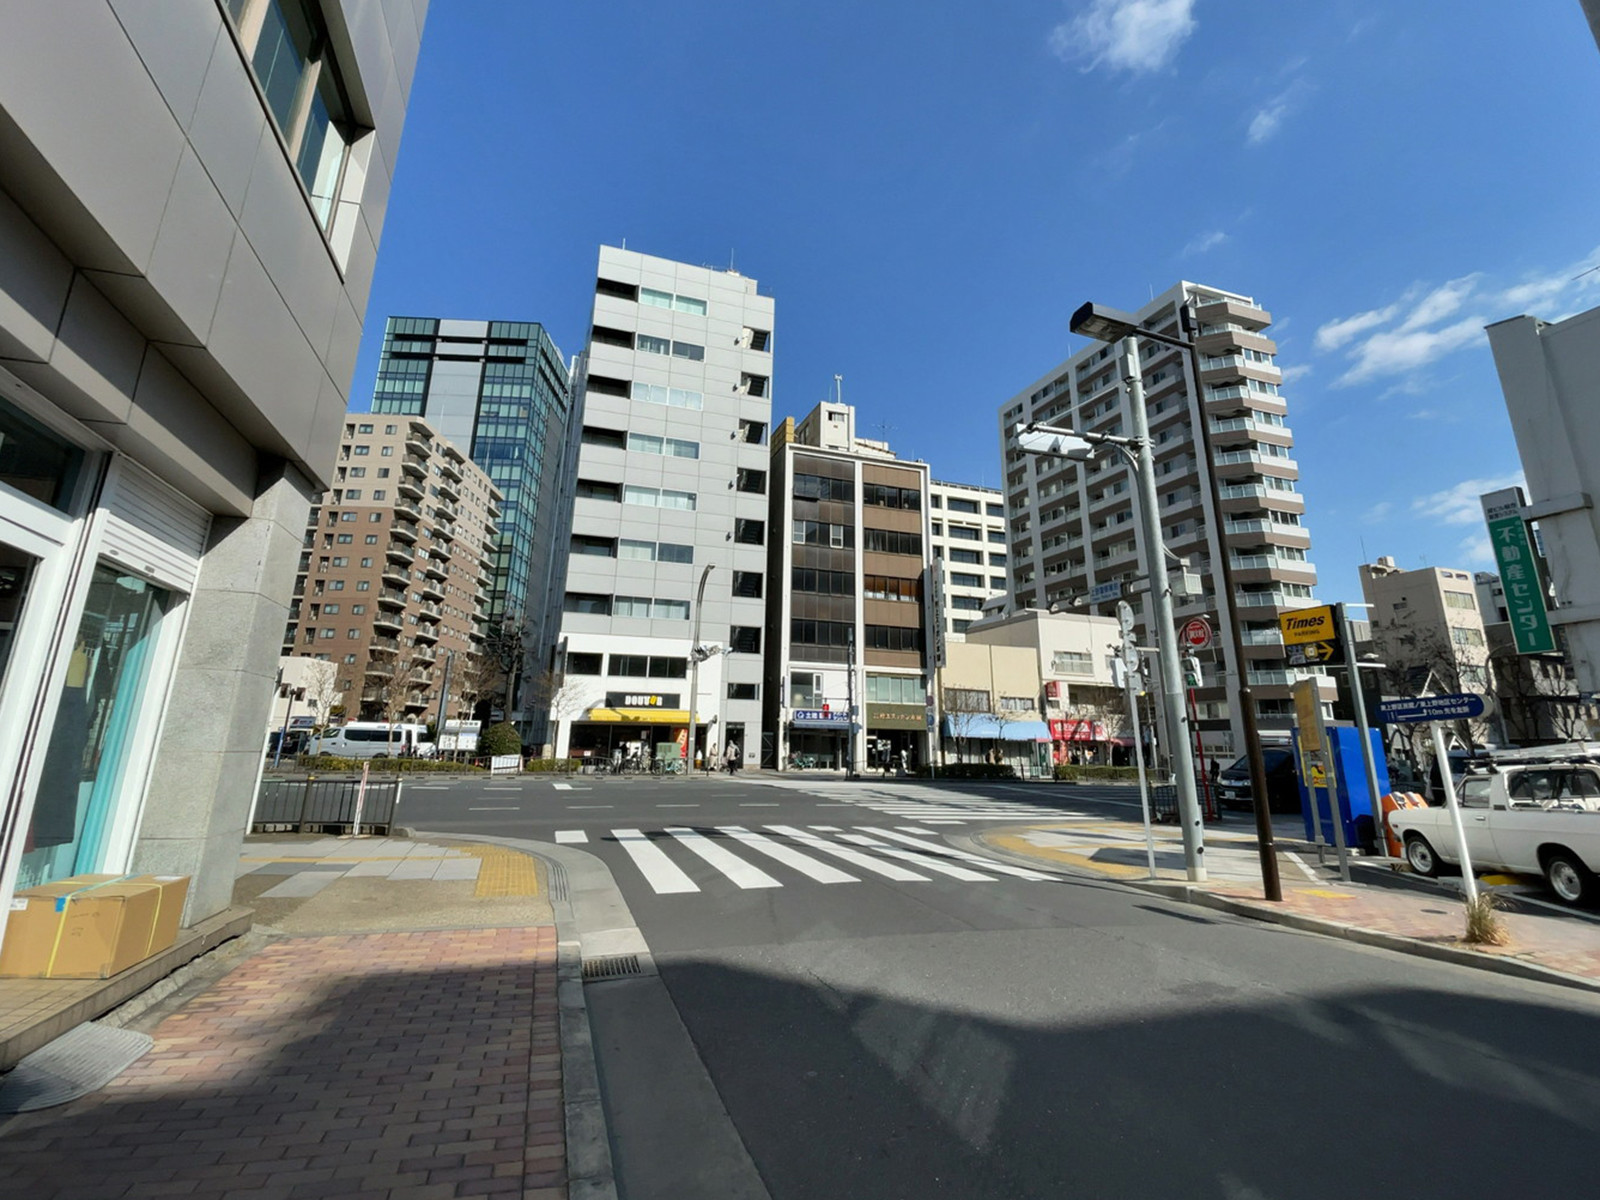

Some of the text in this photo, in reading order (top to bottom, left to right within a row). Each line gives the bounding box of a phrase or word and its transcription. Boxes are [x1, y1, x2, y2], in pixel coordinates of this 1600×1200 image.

[1497, 526, 1538, 646] 不動産センター
[1286, 616, 1325, 630] Times
[625, 695, 662, 706] DOUTOR
